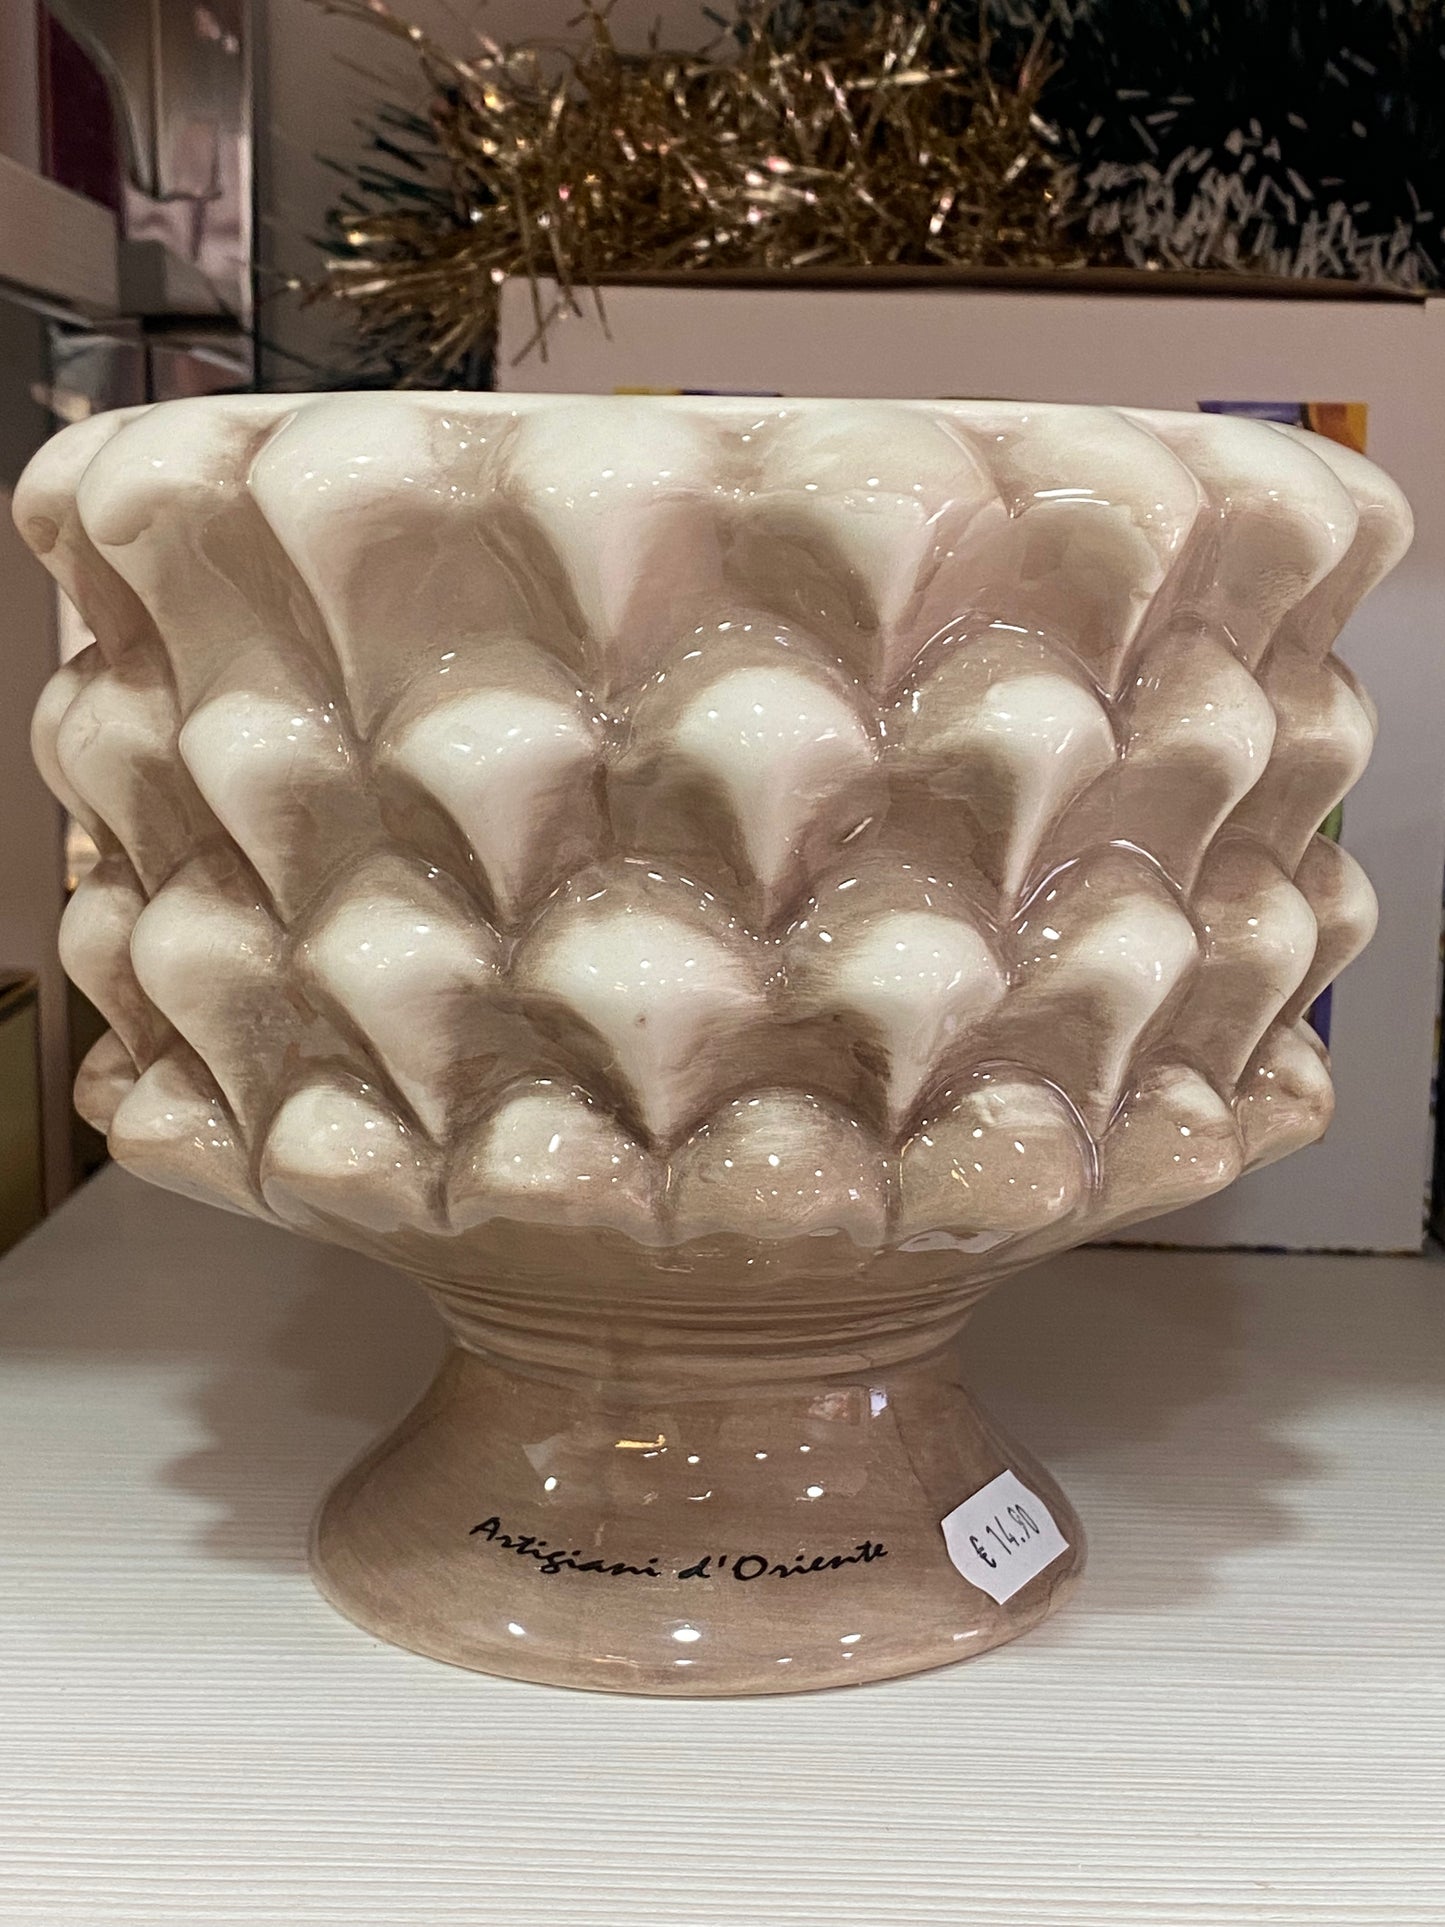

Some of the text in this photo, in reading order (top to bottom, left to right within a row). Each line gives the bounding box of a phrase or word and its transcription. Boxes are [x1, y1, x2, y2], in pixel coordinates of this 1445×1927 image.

[468, 1515, 889, 1582] Artigiani d'Oriente
[968, 1535, 998, 1569] €
